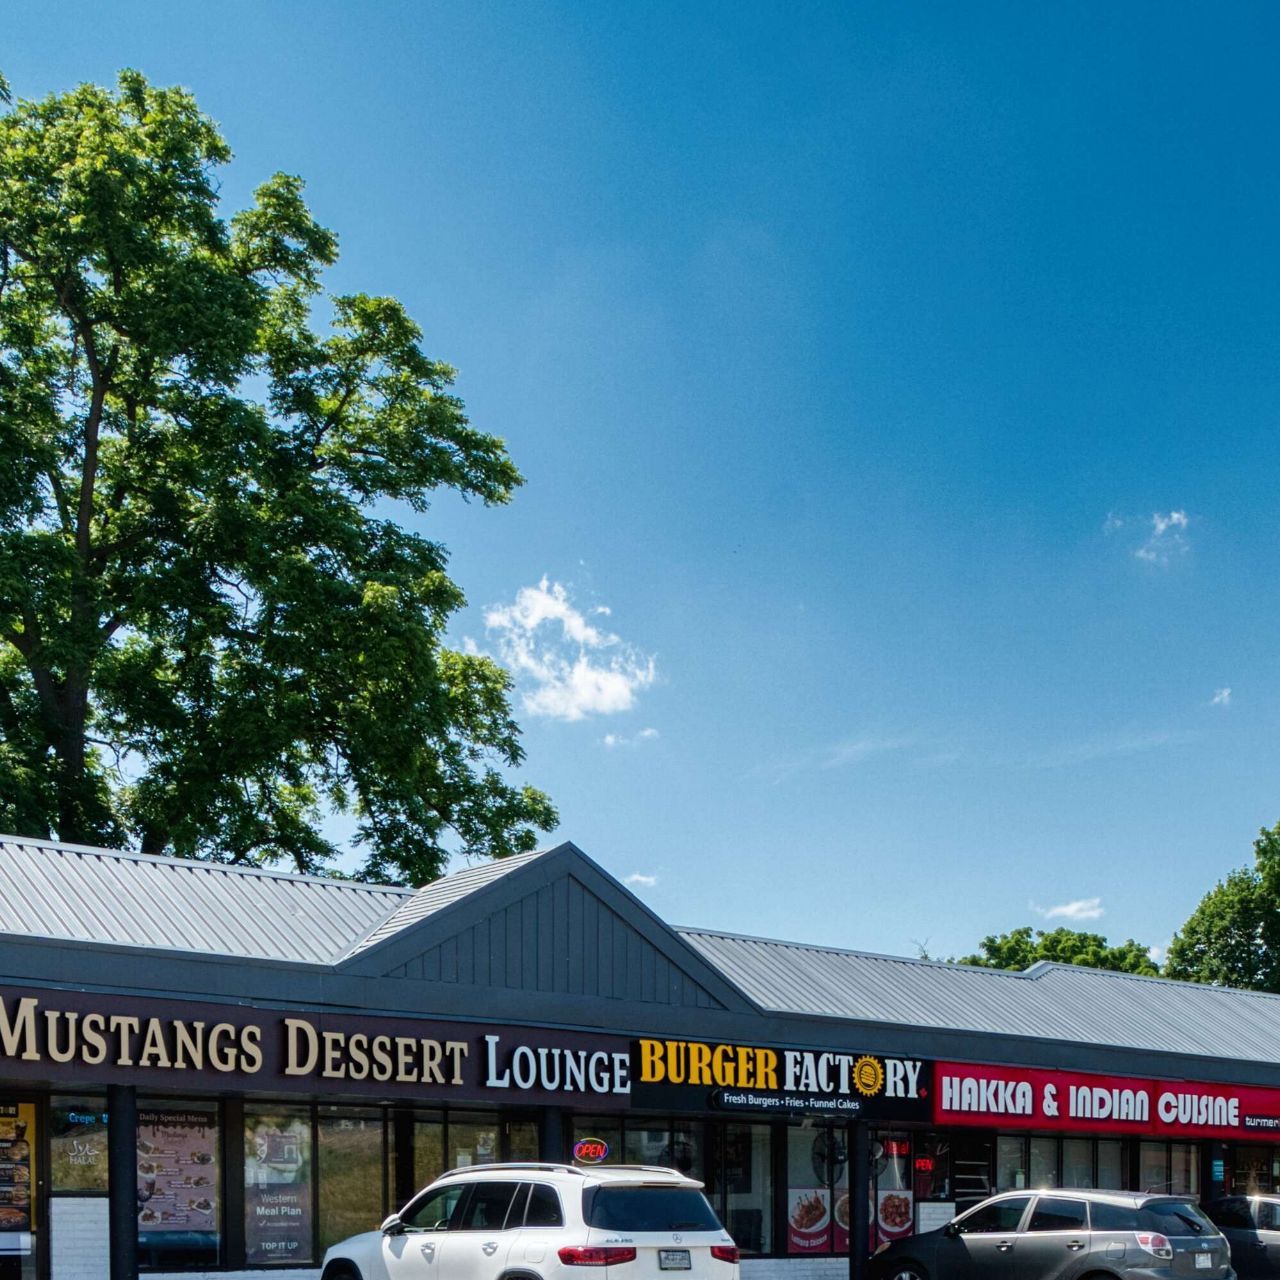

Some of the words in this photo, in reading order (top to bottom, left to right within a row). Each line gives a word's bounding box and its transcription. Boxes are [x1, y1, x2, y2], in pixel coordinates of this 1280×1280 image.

[284, 1018, 468, 1085] DESSERT
[484, 1034, 631, 1095] LOUNGE
[639, 1039, 778, 1090] BURGER
[783, 1050, 922, 1099] FACTORY
[724, 1093, 747, 1104] Fresh
[748, 1094, 780, 1107] Burgers
[785, 1096, 804, 1107] Fries
[810, 1098, 837, 1109] Funnel
[837, 1099, 860, 1110] Cakes
[941, 1075, 1033, 1115] HAKKA
[1042, 1083, 1059, 1117] &
[1069, 1085, 1149, 1121] INDIAN
[1157, 1091, 1239, 1126] CUISINE
[69, 1112, 96, 1125] Crepe
[139, 1113, 158, 1122] Daily
[160, 1113, 186, 1122] Special
[187, 1114, 208, 1123] Menu
[575, 1143, 607, 1159] OPEN
[69, 1156, 97, 1165] HALAL
[915, 1158, 934, 1171] PEN
[260, 1193, 297, 1204] Western
[256, 1206, 279, 1216] Meal
[280, 1206, 302, 1216] Plan
[260, 1242, 277, 1250] TOP
[278, 1242, 286, 1250] IT
[287, 1242, 299, 1250] UP
